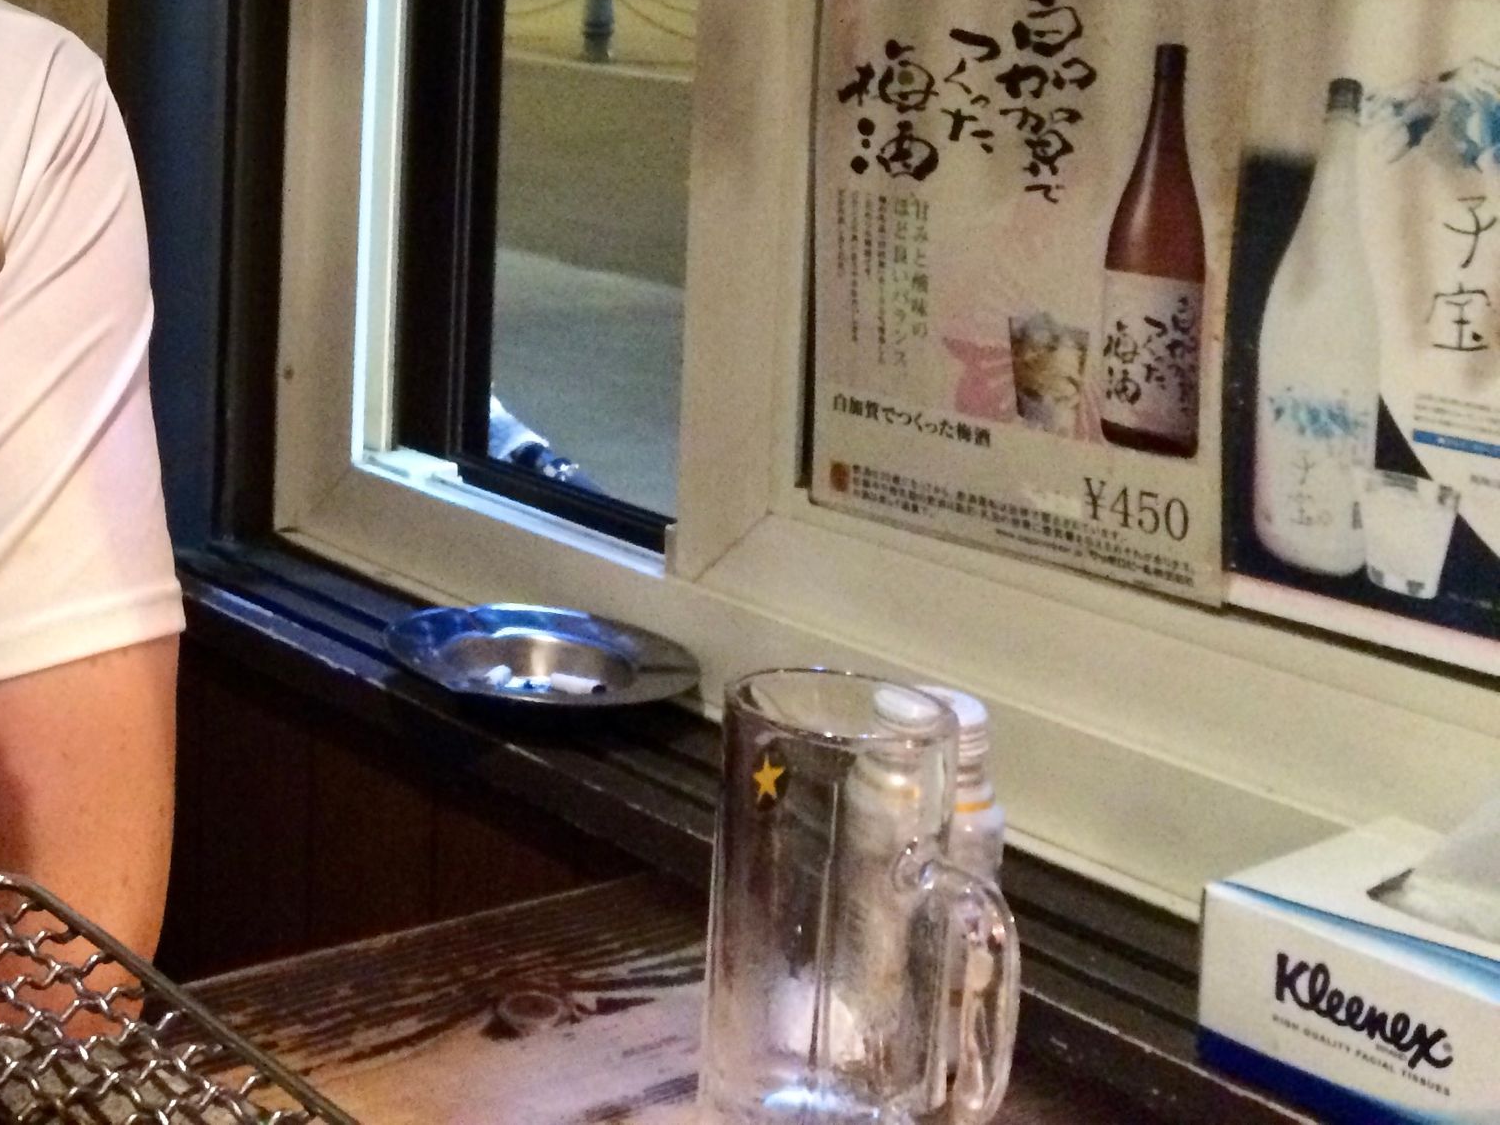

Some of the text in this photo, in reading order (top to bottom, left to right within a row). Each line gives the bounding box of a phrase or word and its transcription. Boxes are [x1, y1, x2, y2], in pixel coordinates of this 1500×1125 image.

[1083, 477, 1190, 542] ¥450
[1274, 950, 1454, 1070] Kleenex
[1402, 1068, 1451, 1097] TISSUES
